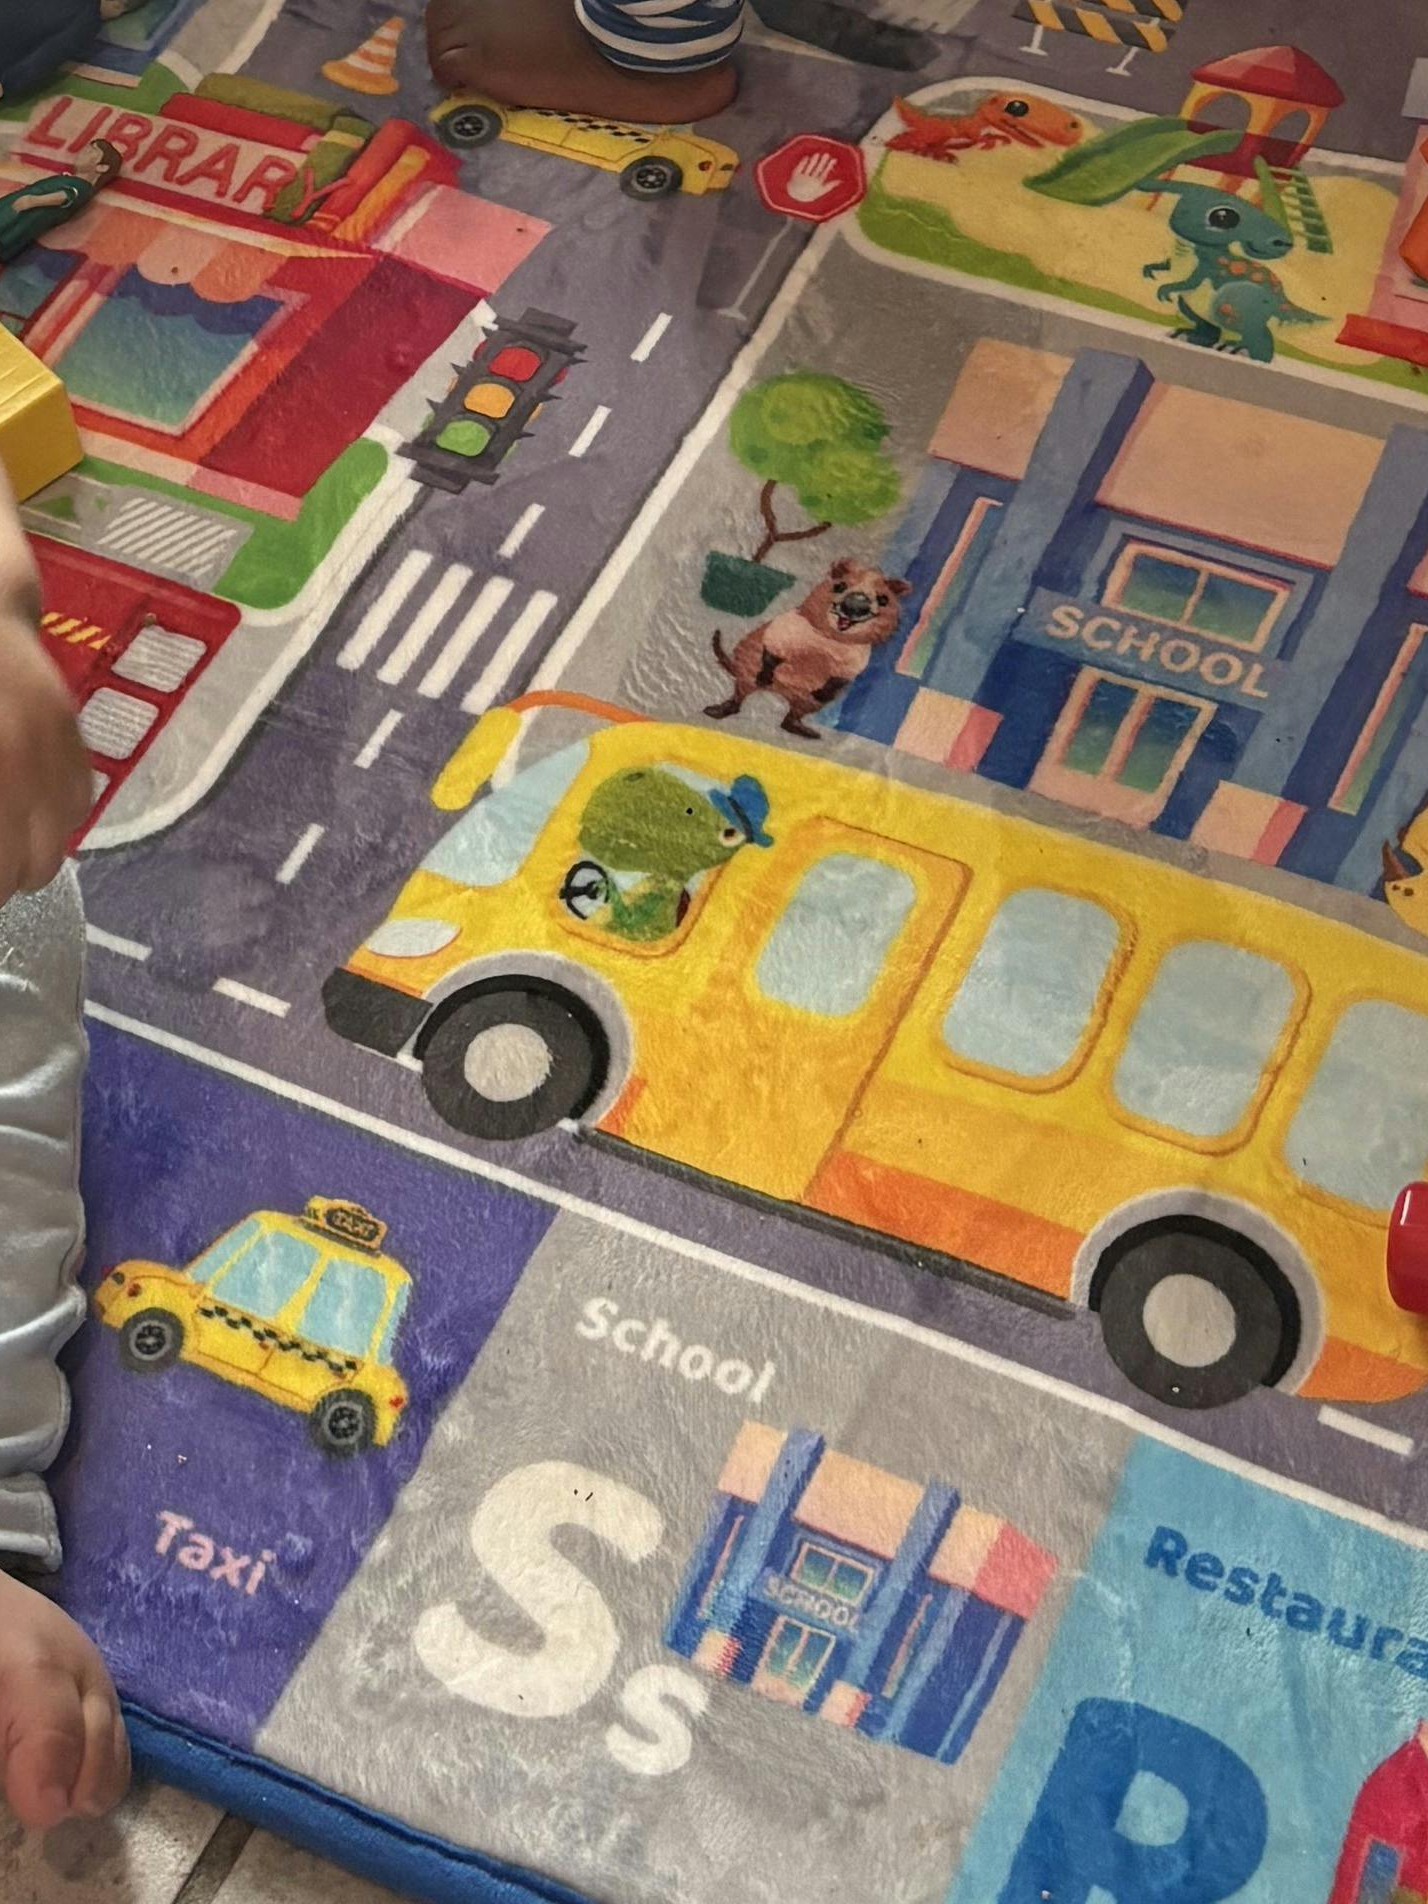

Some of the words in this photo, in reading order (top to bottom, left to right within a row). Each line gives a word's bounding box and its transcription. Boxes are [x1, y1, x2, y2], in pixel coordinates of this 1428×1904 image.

[24, 95, 349, 220] LIBRARY
[1043, 602, 1271, 700] SCHOOL
[575, 1294, 778, 1405] School
[153, 1509, 275, 1597] Taxi
